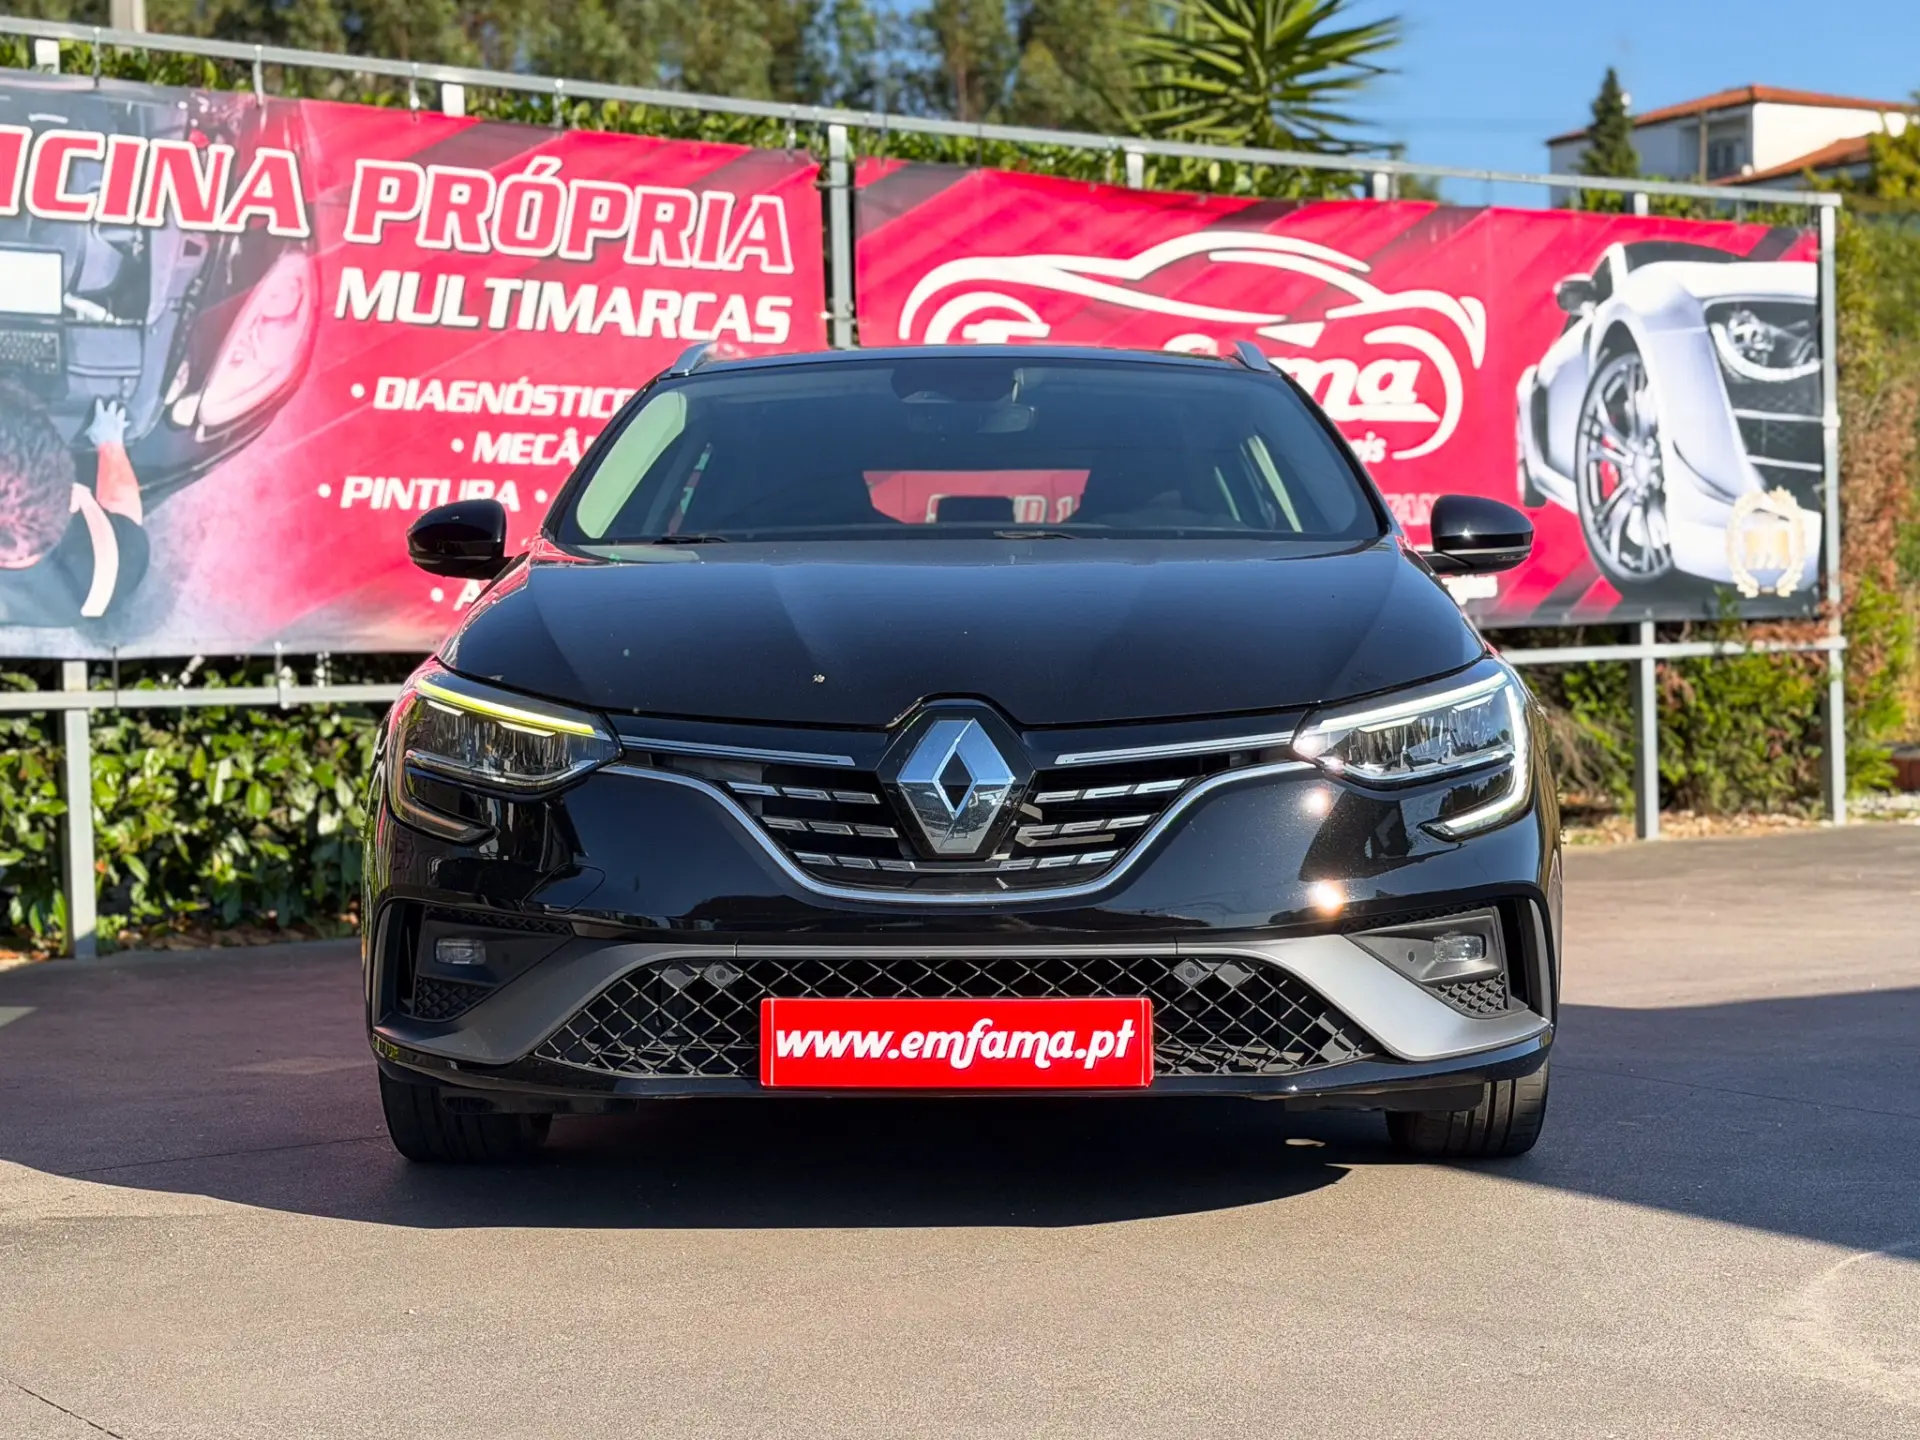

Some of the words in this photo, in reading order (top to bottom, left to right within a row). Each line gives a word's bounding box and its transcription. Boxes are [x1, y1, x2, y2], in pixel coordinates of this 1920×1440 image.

[343, 156, 795, 275] PRÓPRIA
[334, 267, 793, 344] MULTIMARCAS
[472, 427, 597, 466] MECÂ
[340, 476, 520, 511] PINTURA
[776, 1018, 1135, 1069] www.emfama.pt
